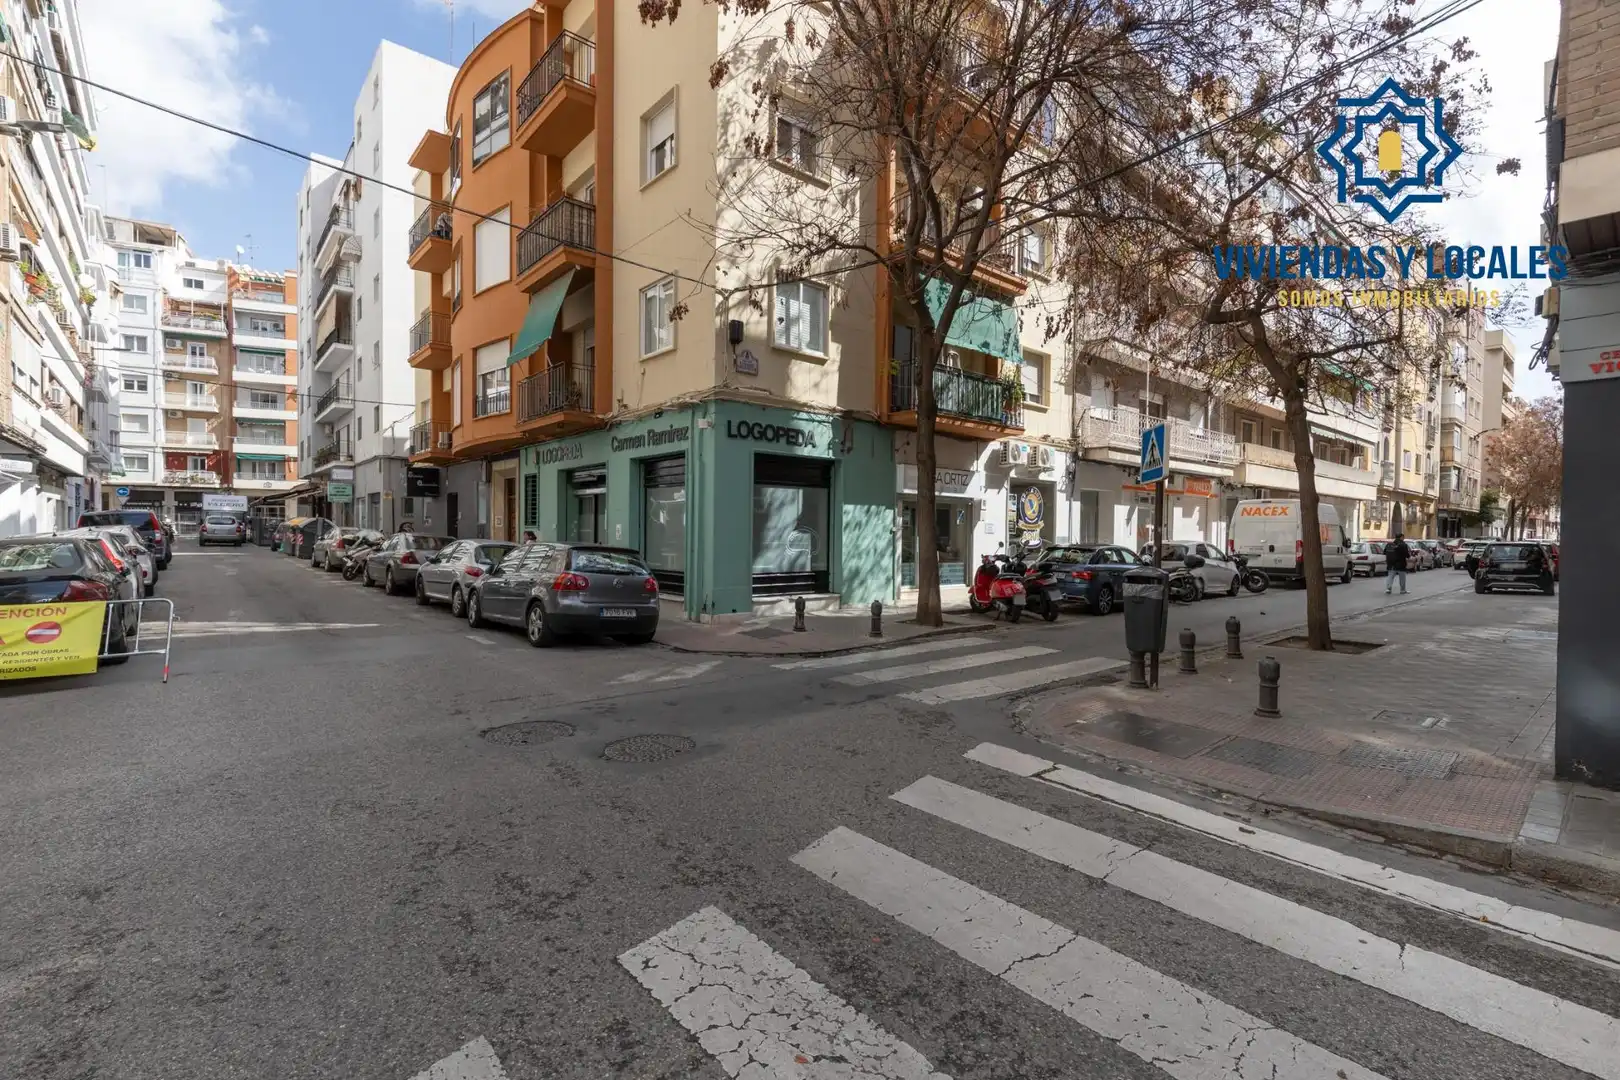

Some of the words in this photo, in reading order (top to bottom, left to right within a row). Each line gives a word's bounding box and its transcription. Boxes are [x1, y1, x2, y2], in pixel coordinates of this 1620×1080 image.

[727, 419, 817, 449] LOGOPEDA
[542, 442, 583, 464] LOGOPEDA
[611, 434, 646, 452] Carmen
[944, 472, 969, 487] ORTIZ
[1241, 505, 1290, 517] NACEX
